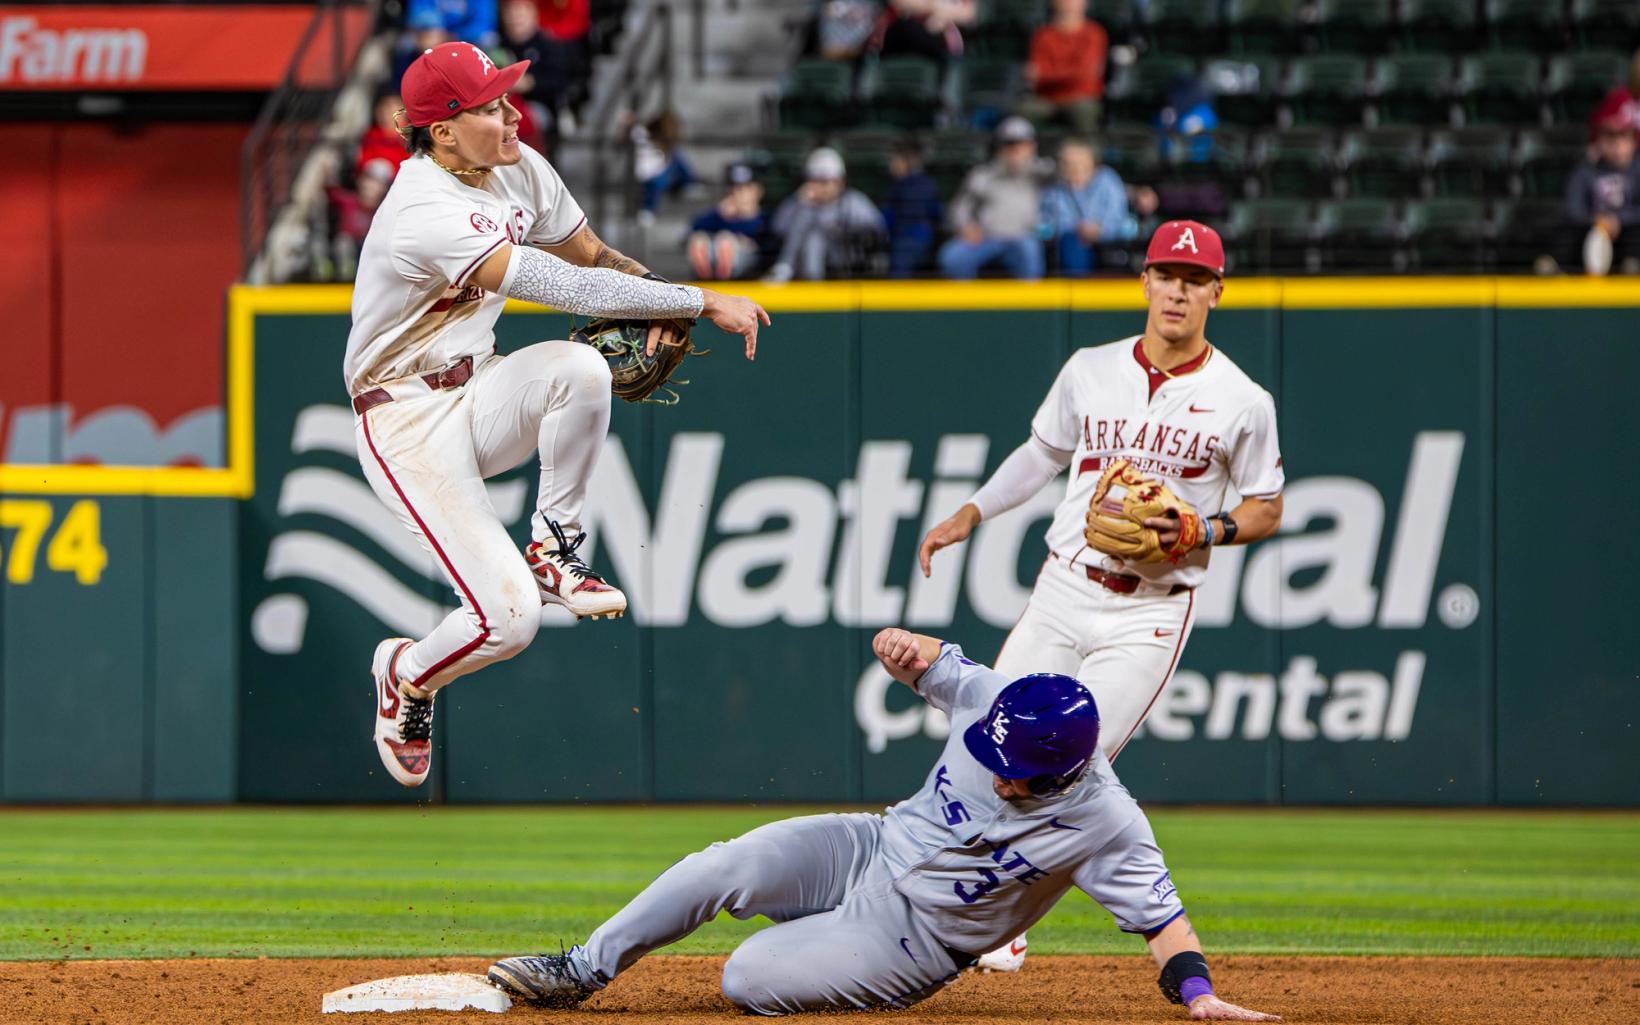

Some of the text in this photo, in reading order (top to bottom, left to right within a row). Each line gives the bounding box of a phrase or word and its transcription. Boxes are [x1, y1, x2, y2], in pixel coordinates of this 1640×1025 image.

[0, 15, 148, 82] Farm
[1171, 227, 1199, 254] A
[1084, 415, 1219, 464] ARKANSAS
[0, 499, 108, 586] 74
[1135, 650, 1426, 742] ental
[954, 867, 999, 904] 3
